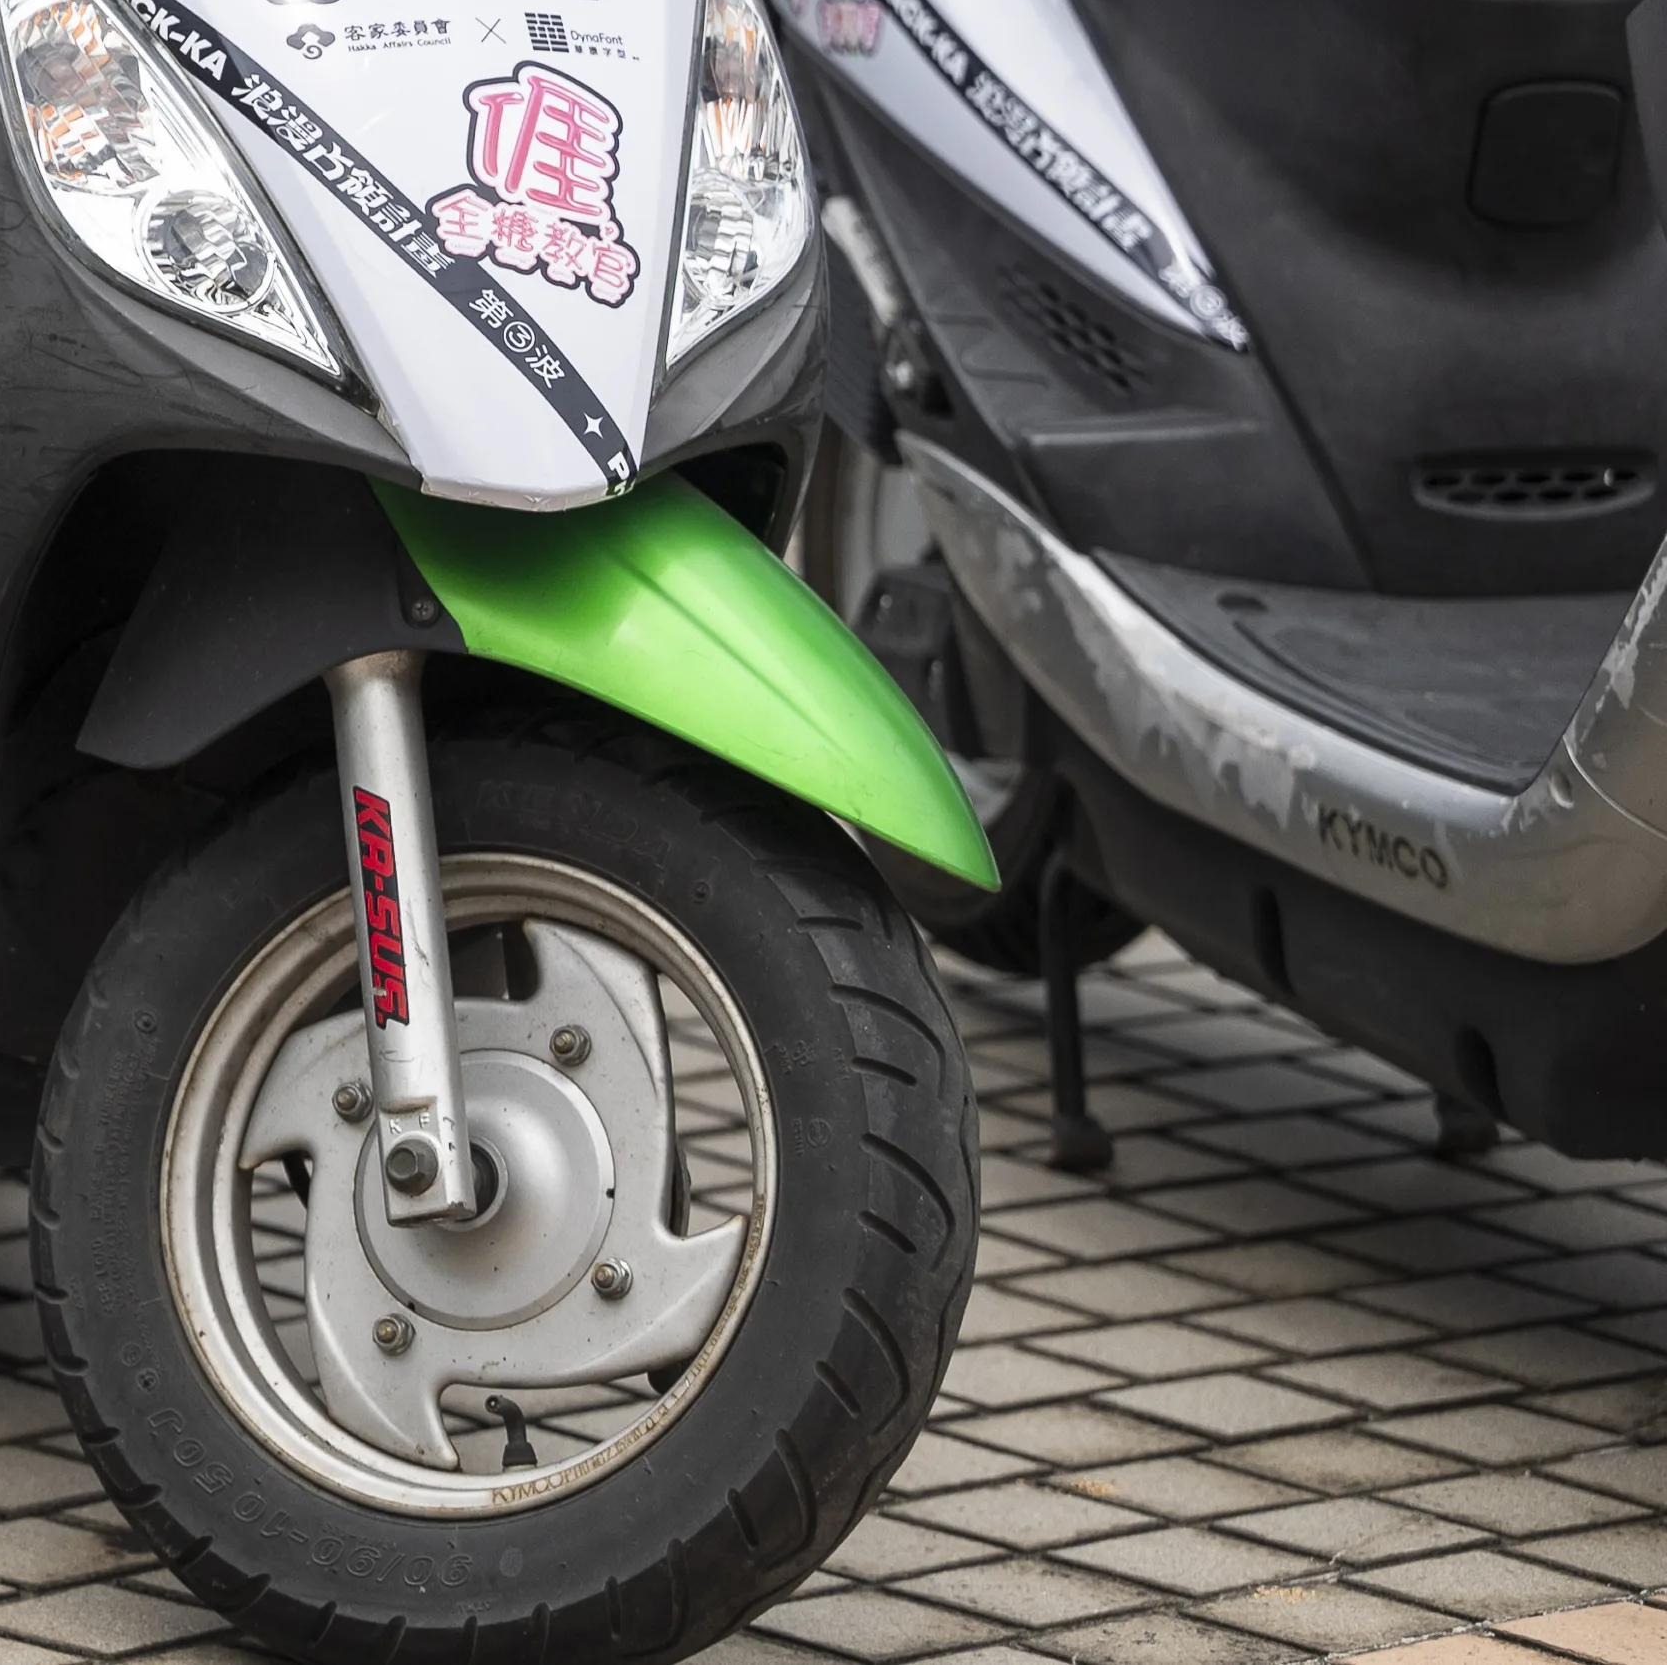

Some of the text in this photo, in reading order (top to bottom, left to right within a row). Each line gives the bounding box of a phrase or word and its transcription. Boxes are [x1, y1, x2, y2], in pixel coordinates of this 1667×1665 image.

[343, 18, 452, 42] 客家委員會
[570, 29, 625, 47] DynaFont
[417, 37, 452, 48] Council
[1318, 807, 1450, 889] KYMCO
[230, 1490, 474, 1588] 90/90-10
